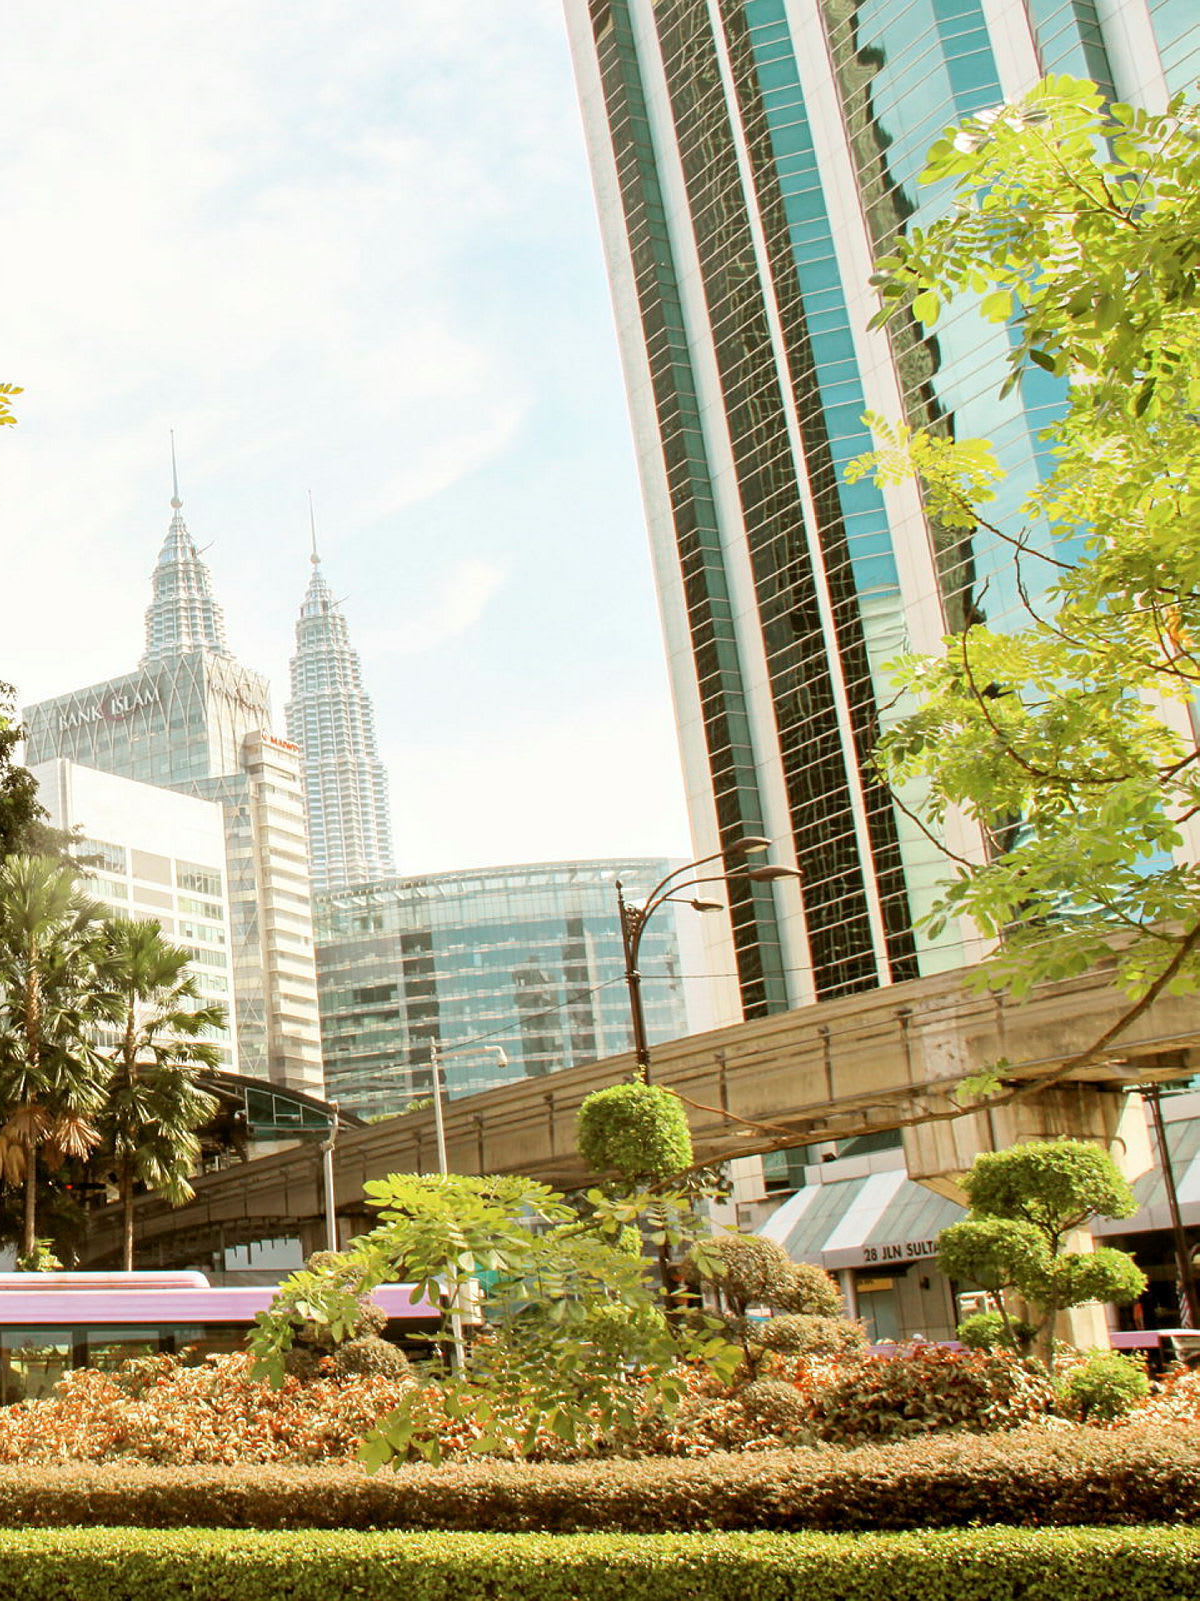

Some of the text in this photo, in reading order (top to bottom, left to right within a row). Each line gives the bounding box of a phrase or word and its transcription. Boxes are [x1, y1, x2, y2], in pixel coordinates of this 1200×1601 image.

[59, 688, 161, 731] BANK ISLAM
[863, 1248, 878, 1261] 28
[882, 1245, 902, 1260] JLN
